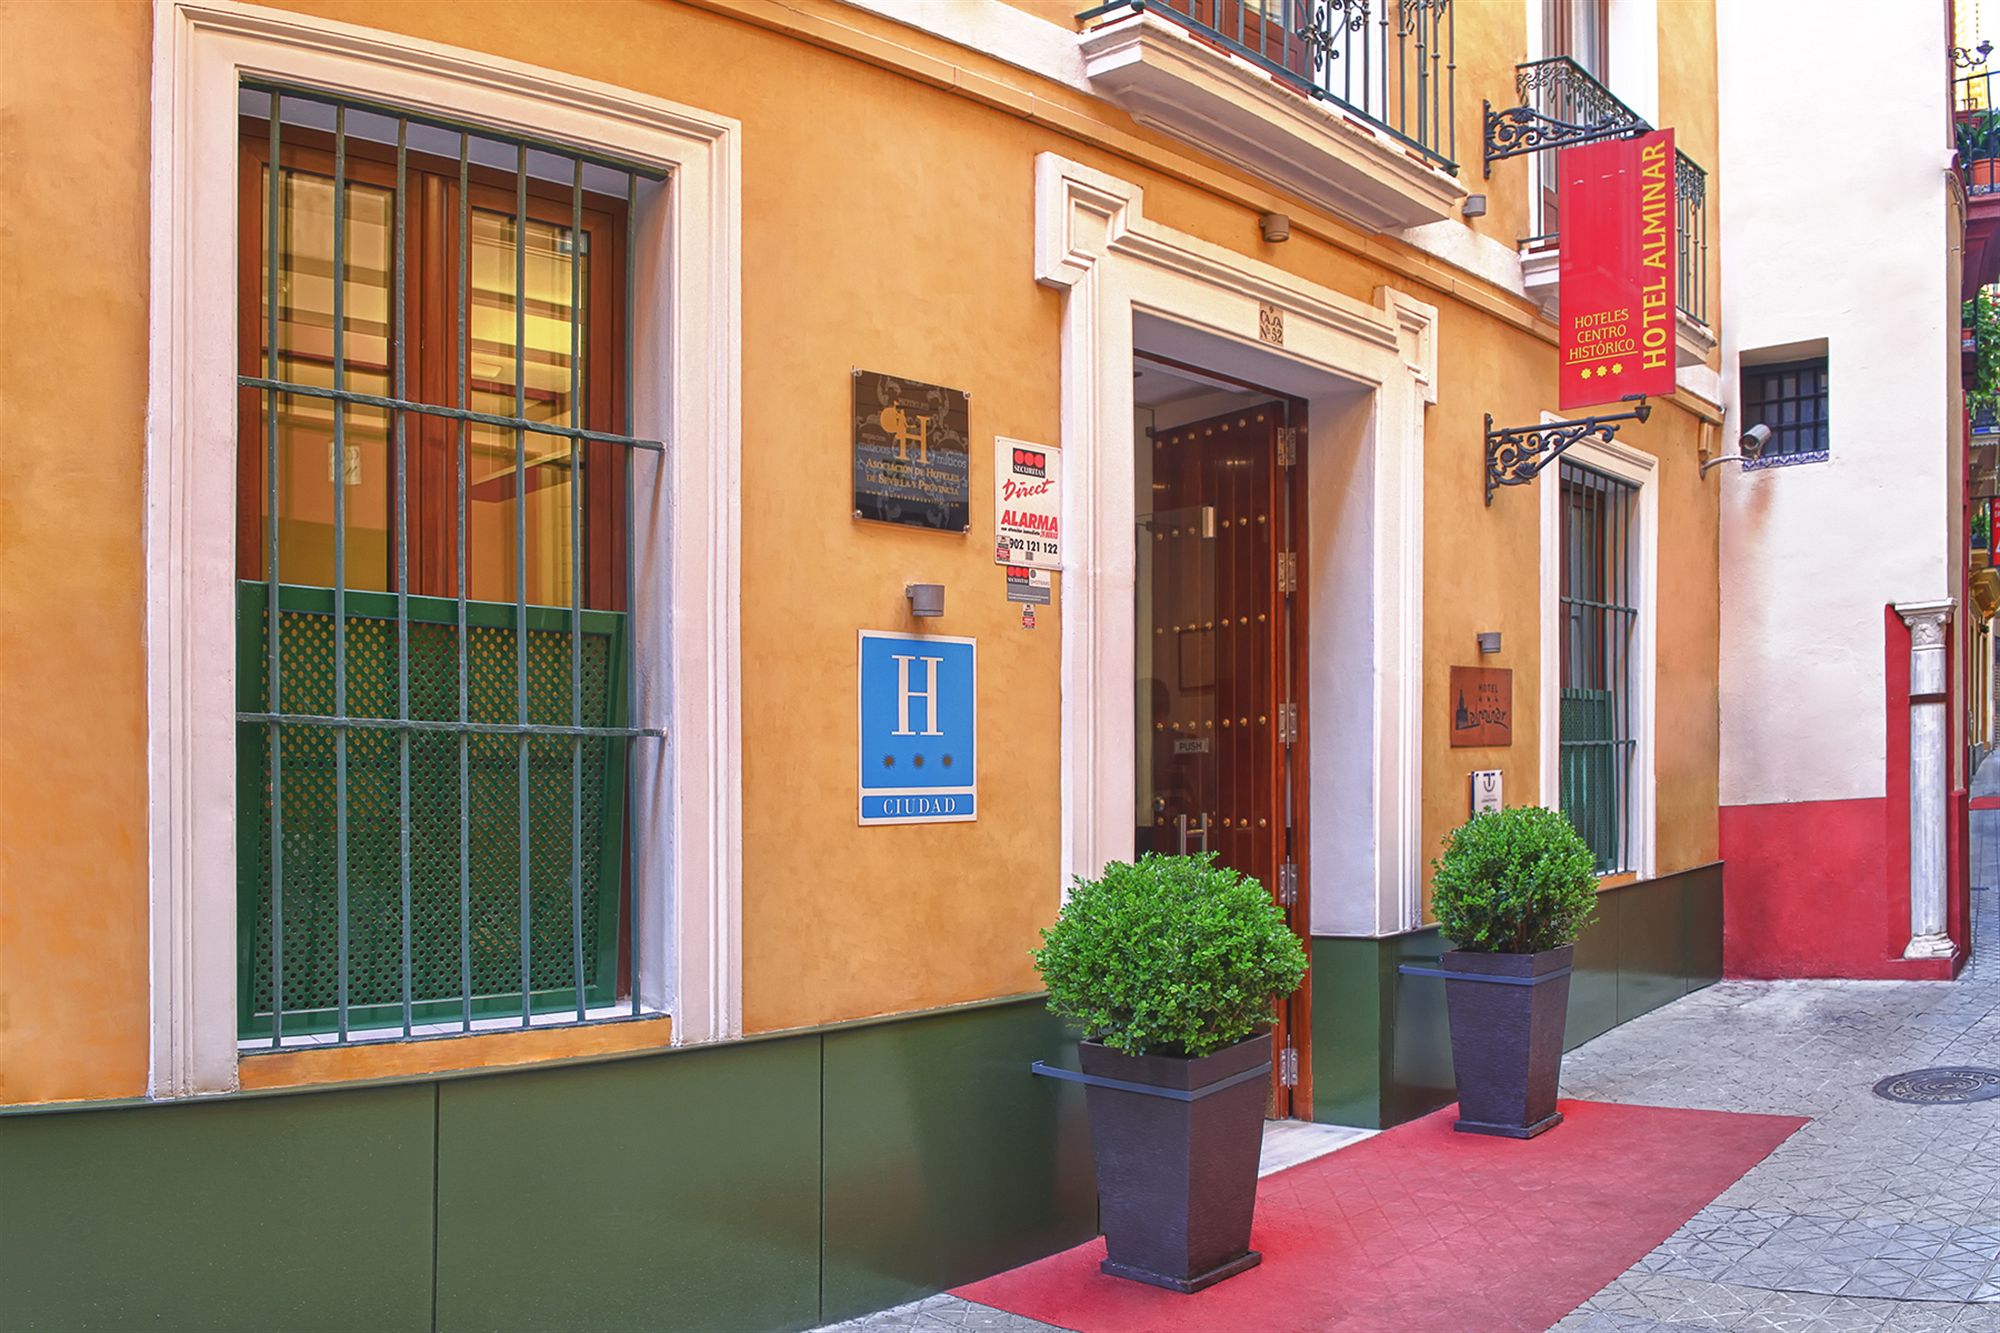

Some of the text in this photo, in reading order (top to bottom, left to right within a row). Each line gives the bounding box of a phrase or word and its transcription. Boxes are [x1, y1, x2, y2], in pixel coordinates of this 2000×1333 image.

[1642, 140, 1667, 371] HOTEL ALMINAR
[1574, 308, 1629, 329] HOTELES
[1577, 324, 1627, 343] CENTRO
[1569, 338, 1635, 360] HISTÓRICO
[926, 468, 961, 483] HOTELES
[1014, 465, 1044, 476] SECURITAS
[879, 473, 909, 488] SEVILLA
[918, 479, 960, 496] PROVINCIA
[1002, 478, 1055, 502] Direct
[1001, 509, 1058, 531] ALARMA
[1009, 538, 1058, 555] 902 121 122
[891, 654, 944, 736] H
[1478, 683, 1498, 693] HOTEL
[1179, 741, 1202, 752] PUSH
[883, 798, 956, 815] CIUDAD
